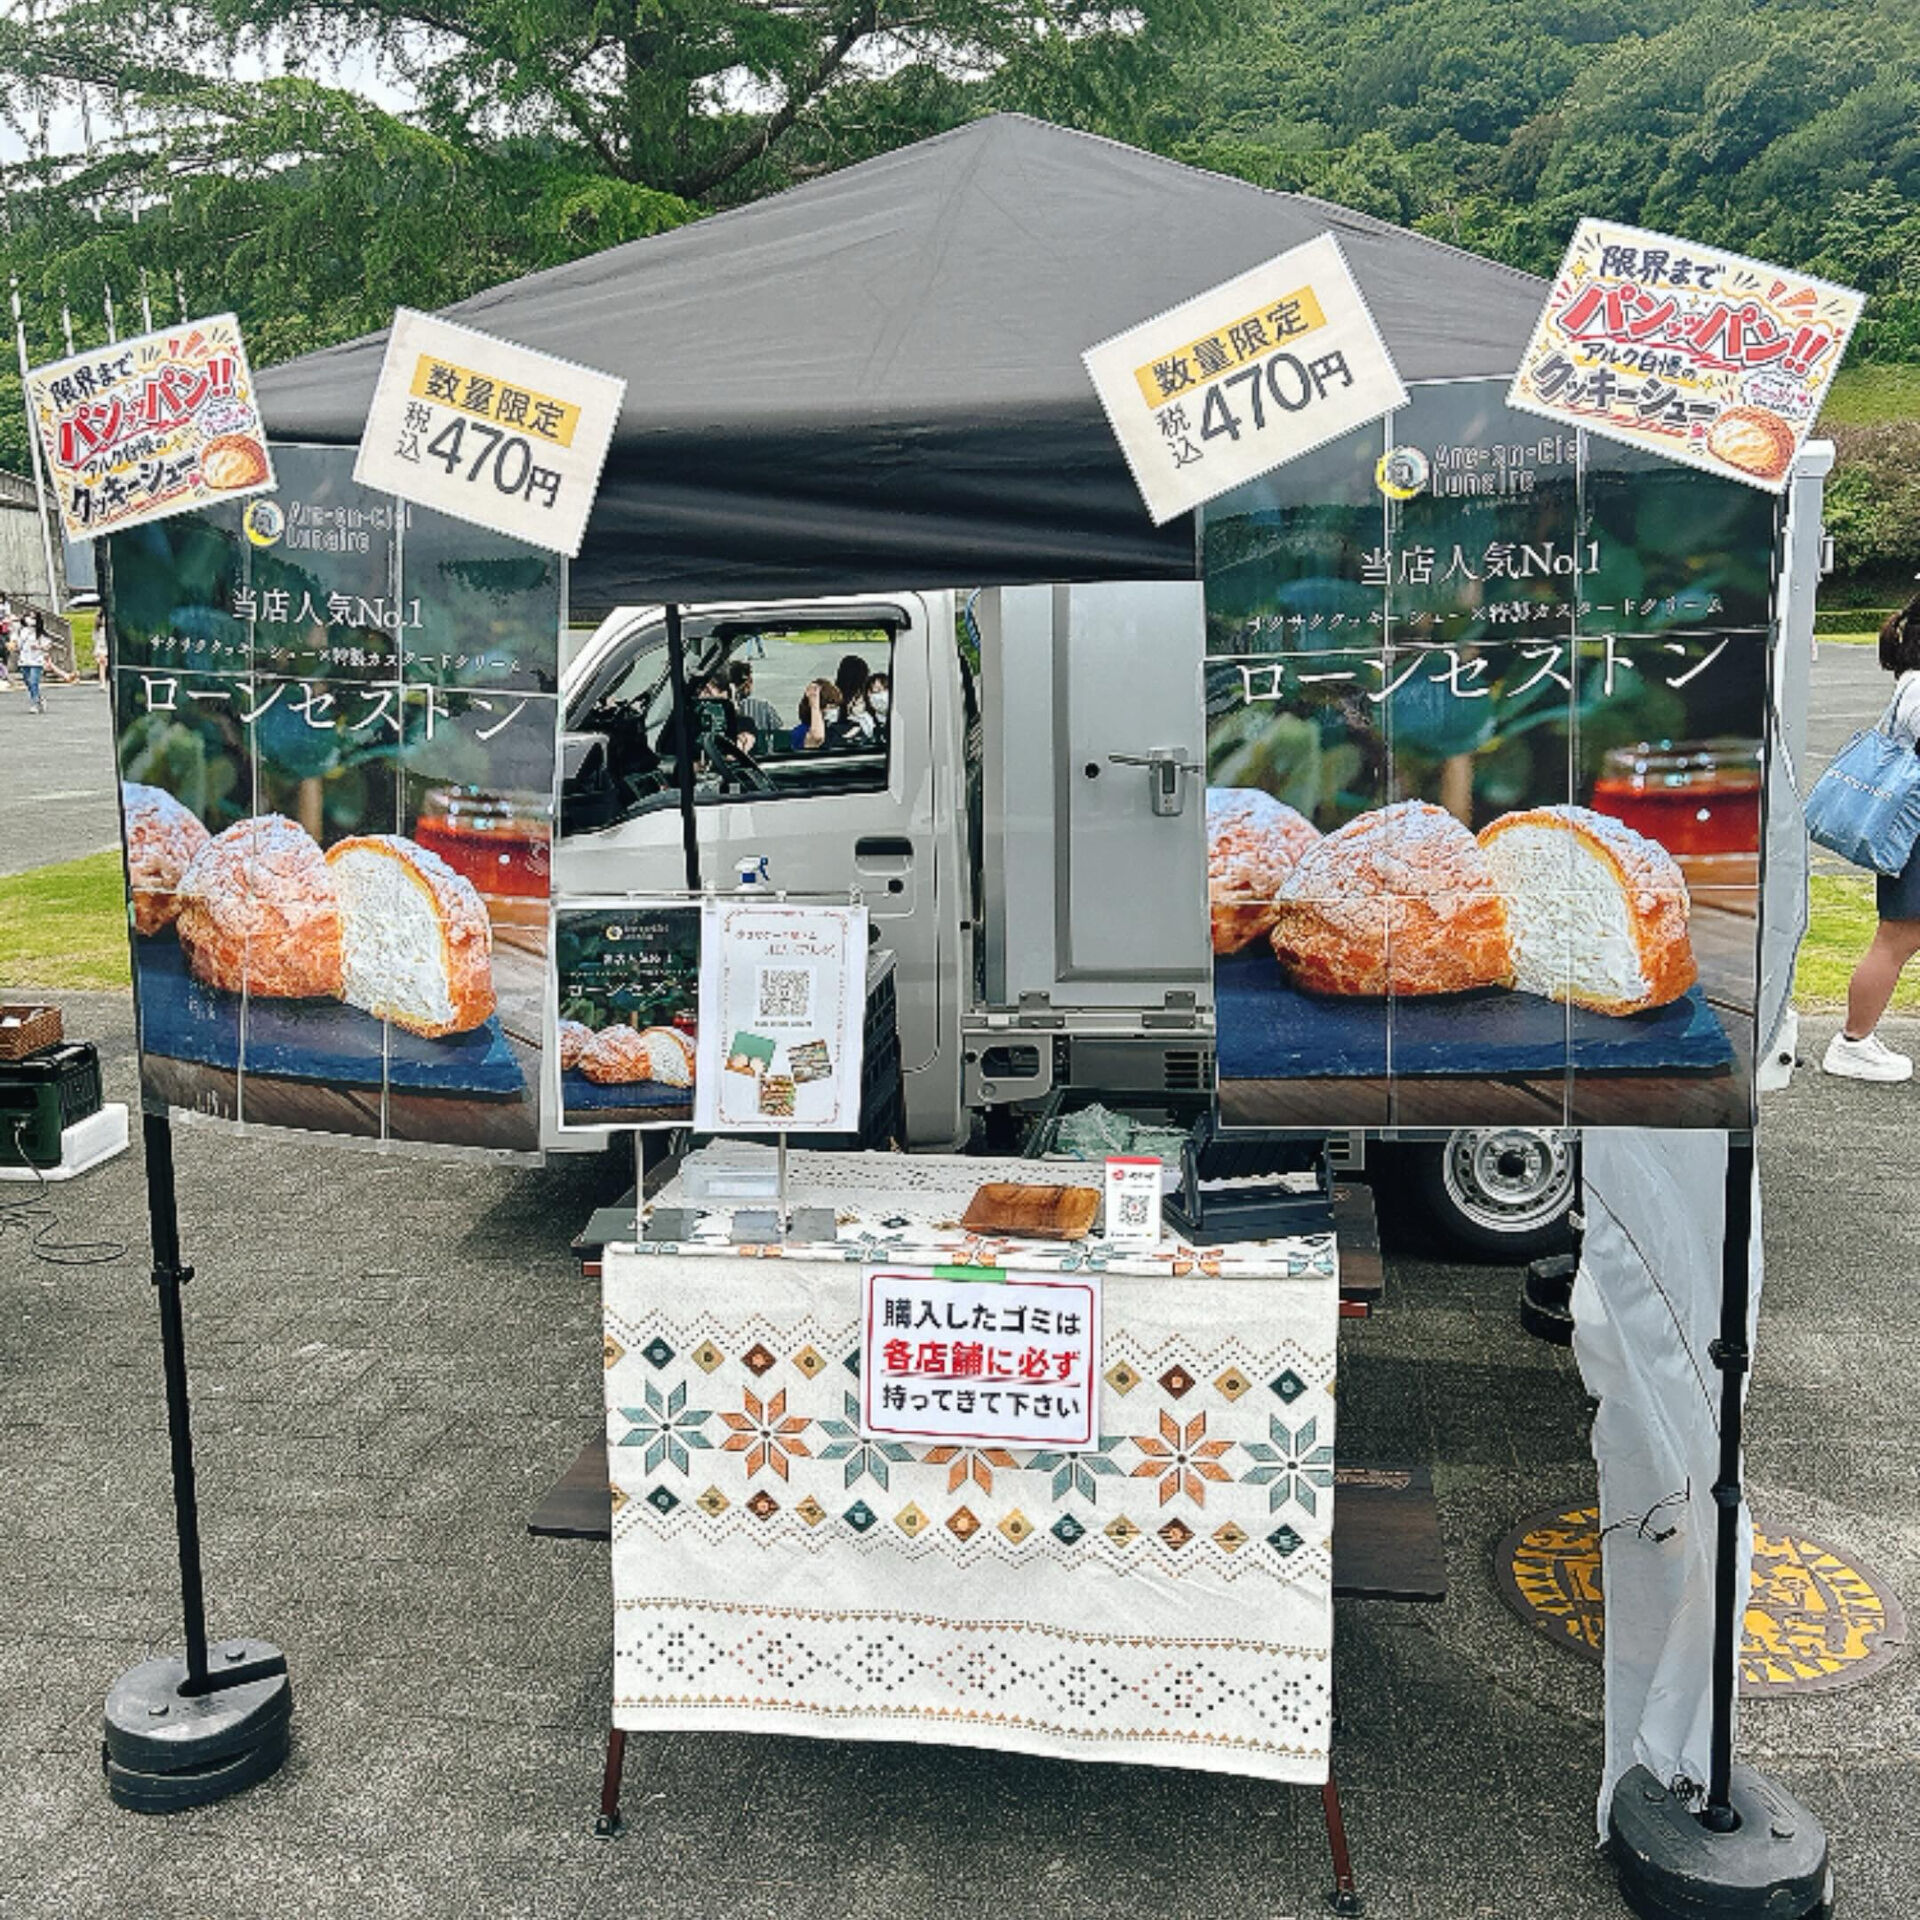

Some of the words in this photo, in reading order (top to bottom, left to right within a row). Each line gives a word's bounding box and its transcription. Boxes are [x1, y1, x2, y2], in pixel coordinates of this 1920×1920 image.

[1600, 245, 1726, 290] 限界まで
[1153, 299, 1309, 396] 数量限定
[1582, 342, 1697, 381] アルク自慢の
[49, 351, 134, 412] 限界まで
[425, 364, 565, 439] 数量限定
[1200, 350, 1353, 442] 470円
[1531, 353, 1718, 424] クッキーシュー
[395, 401, 433, 463] 税込
[427, 416, 561, 508] 470円
[1156, 402, 1204, 469] 税込
[72, 454, 196, 523] クッキーシュー
[1361, 541, 1600, 585] 当店人気No.1
[231, 588, 424, 629] 当店人気No.1
[1236, 634, 1729, 705] ローンセストン
[140, 674, 528, 741] ローンセストン
[882, 1297, 1081, 1336] 購入したゴミは
[882, 1338, 1081, 1380] 各店舗に必ず
[882, 1383, 1081, 1419] 持ってきて下さい
